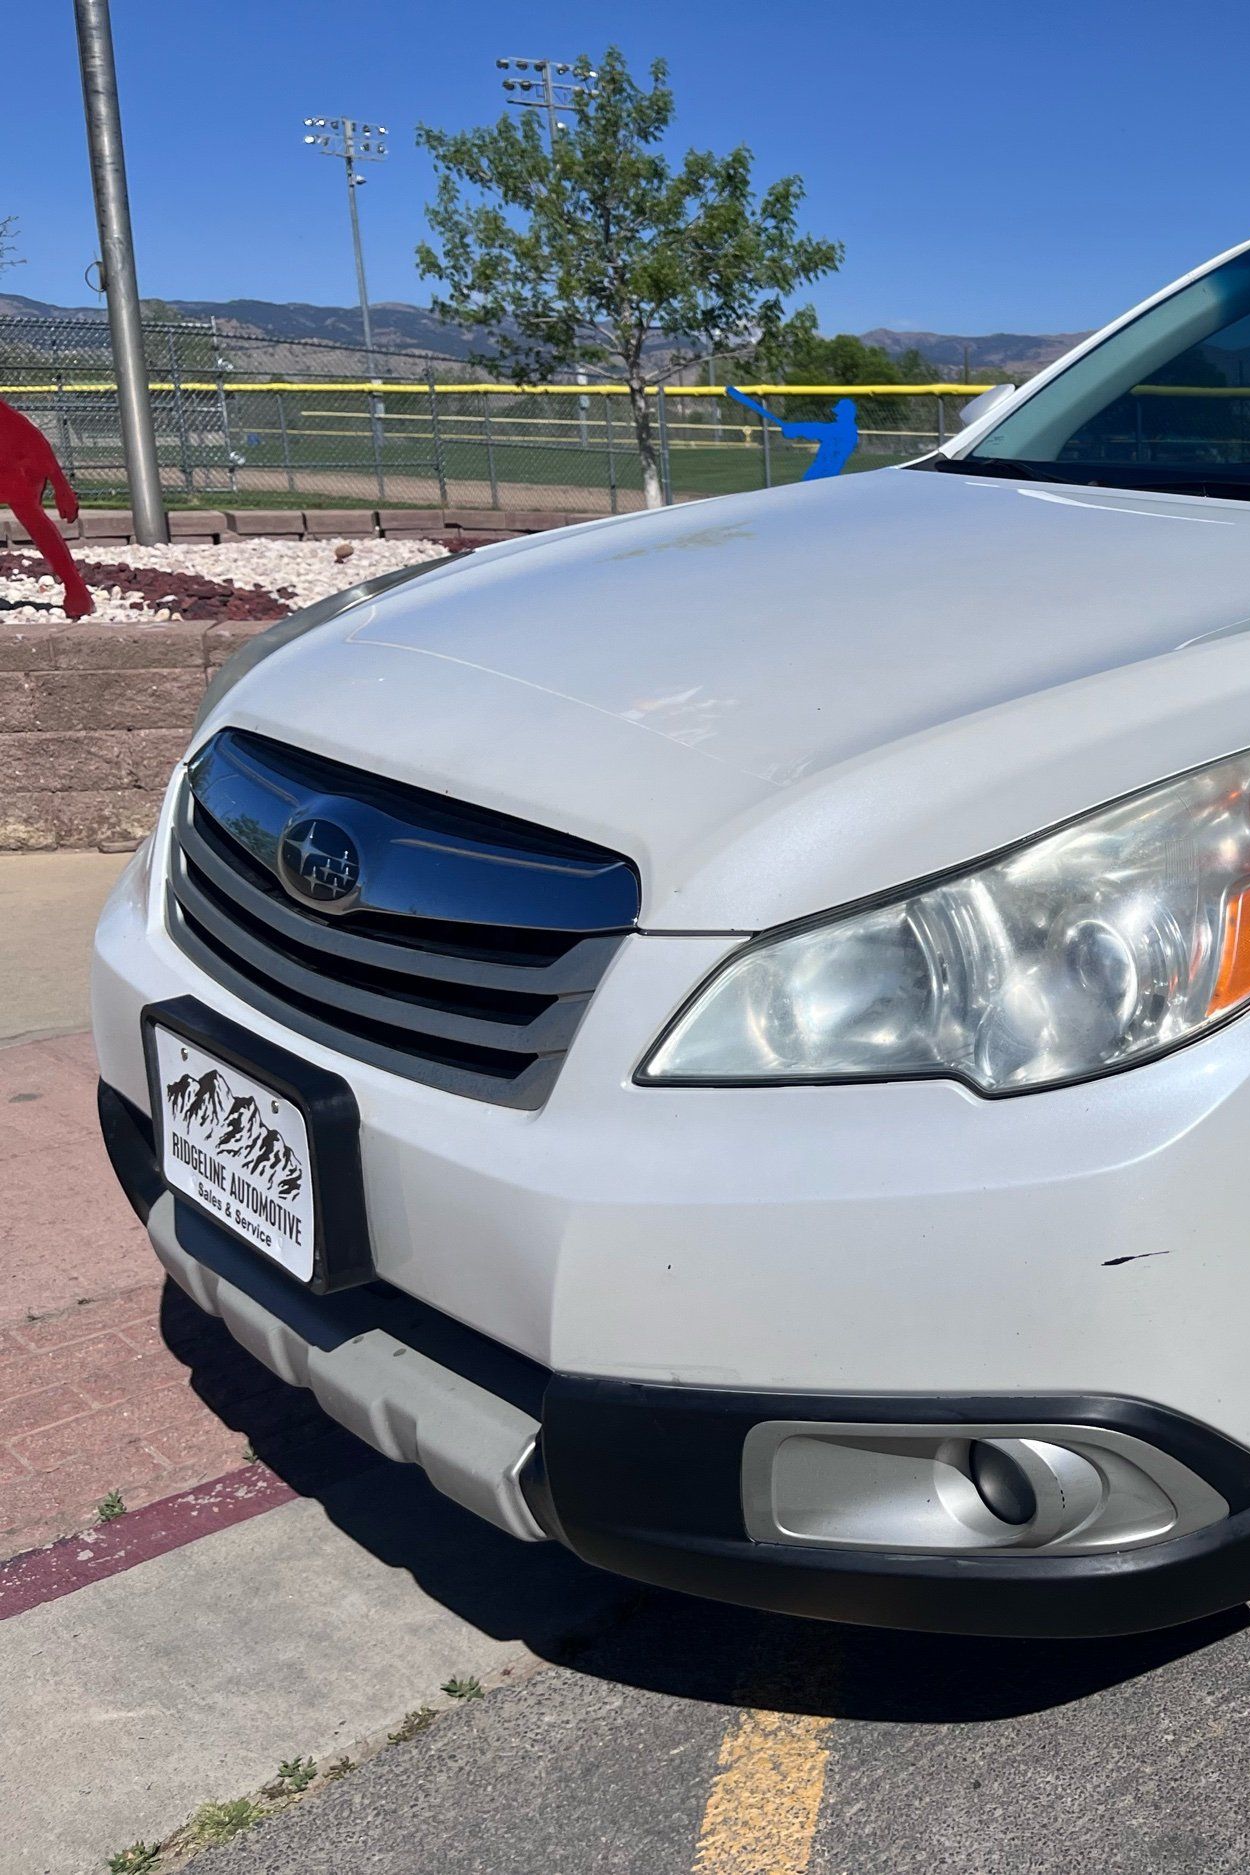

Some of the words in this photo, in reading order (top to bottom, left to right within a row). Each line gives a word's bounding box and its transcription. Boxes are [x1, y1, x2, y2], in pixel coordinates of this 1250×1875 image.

[172, 1131, 227, 1192] RIDGELINE
[229, 1171, 302, 1247] AUTOMOTIVE
[198, 1181, 222, 1211] Sales
[224, 1201, 232, 1218] &
[234, 1210, 272, 1248] Service
